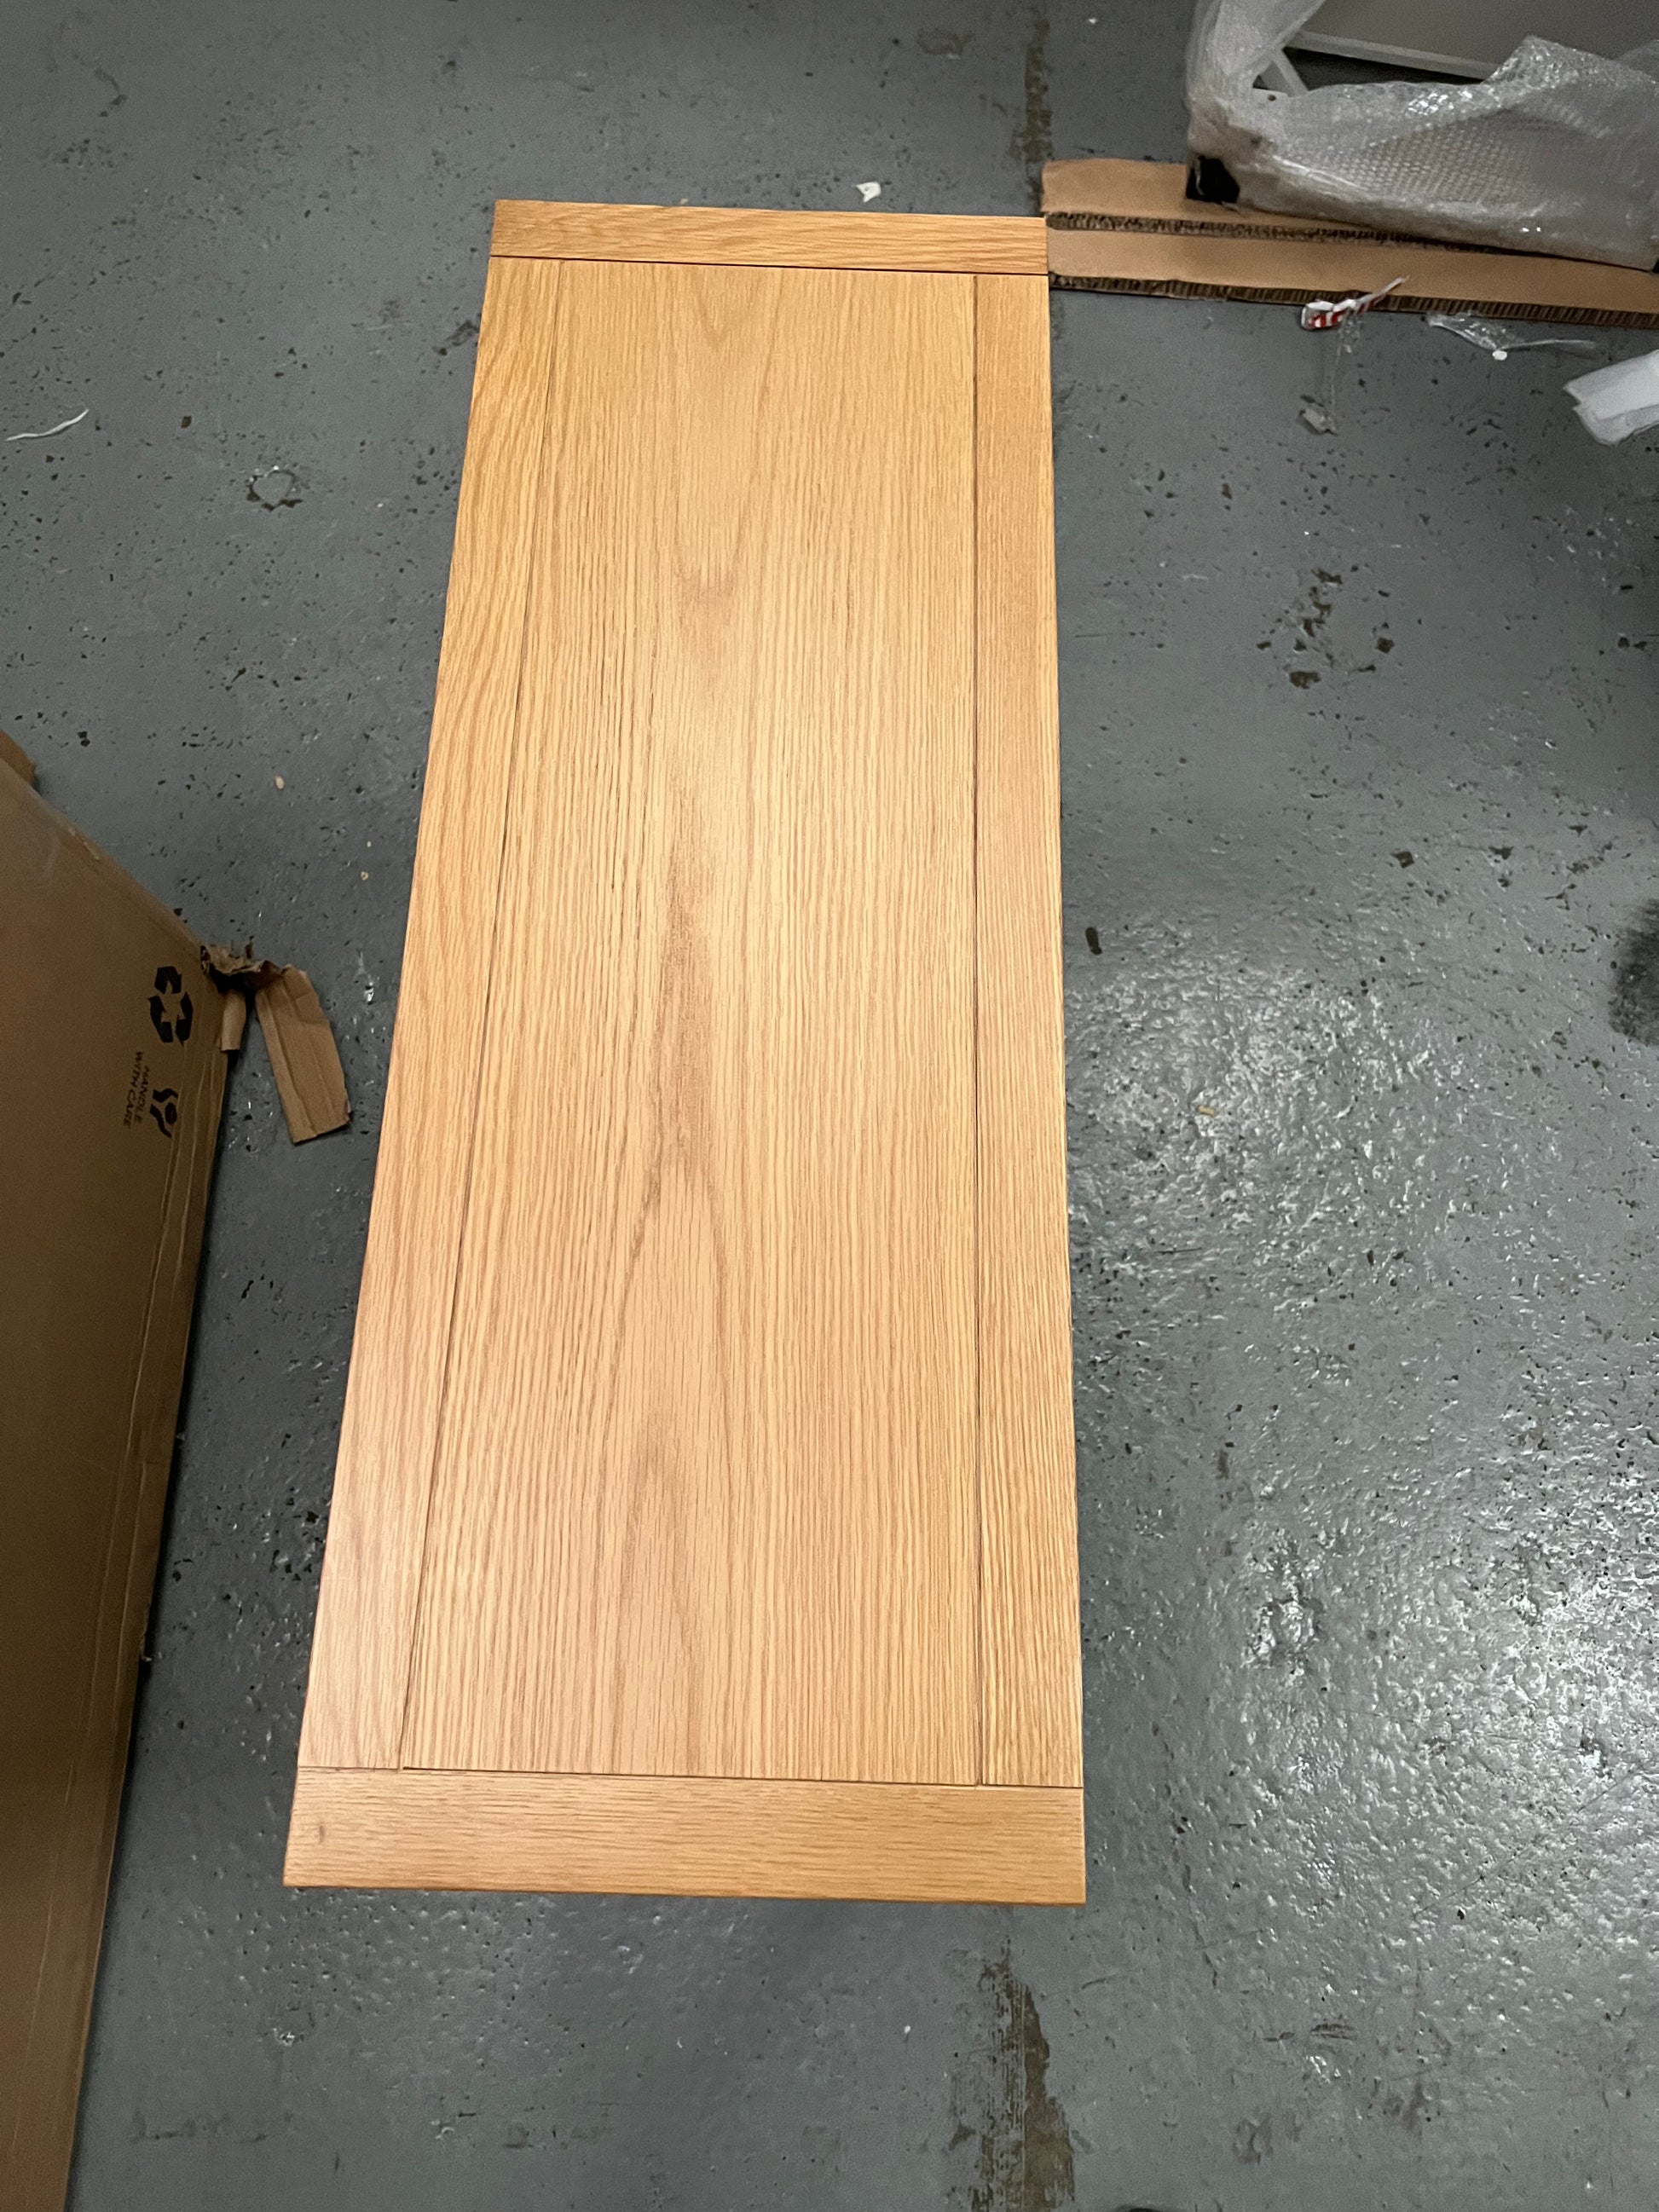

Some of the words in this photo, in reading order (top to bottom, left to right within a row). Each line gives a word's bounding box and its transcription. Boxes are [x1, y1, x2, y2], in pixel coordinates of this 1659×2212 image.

[130, 1051, 144, 1088] WITH
[123, 1089, 136, 1129] CARE
[134, 1066, 150, 1123] HANDLE
